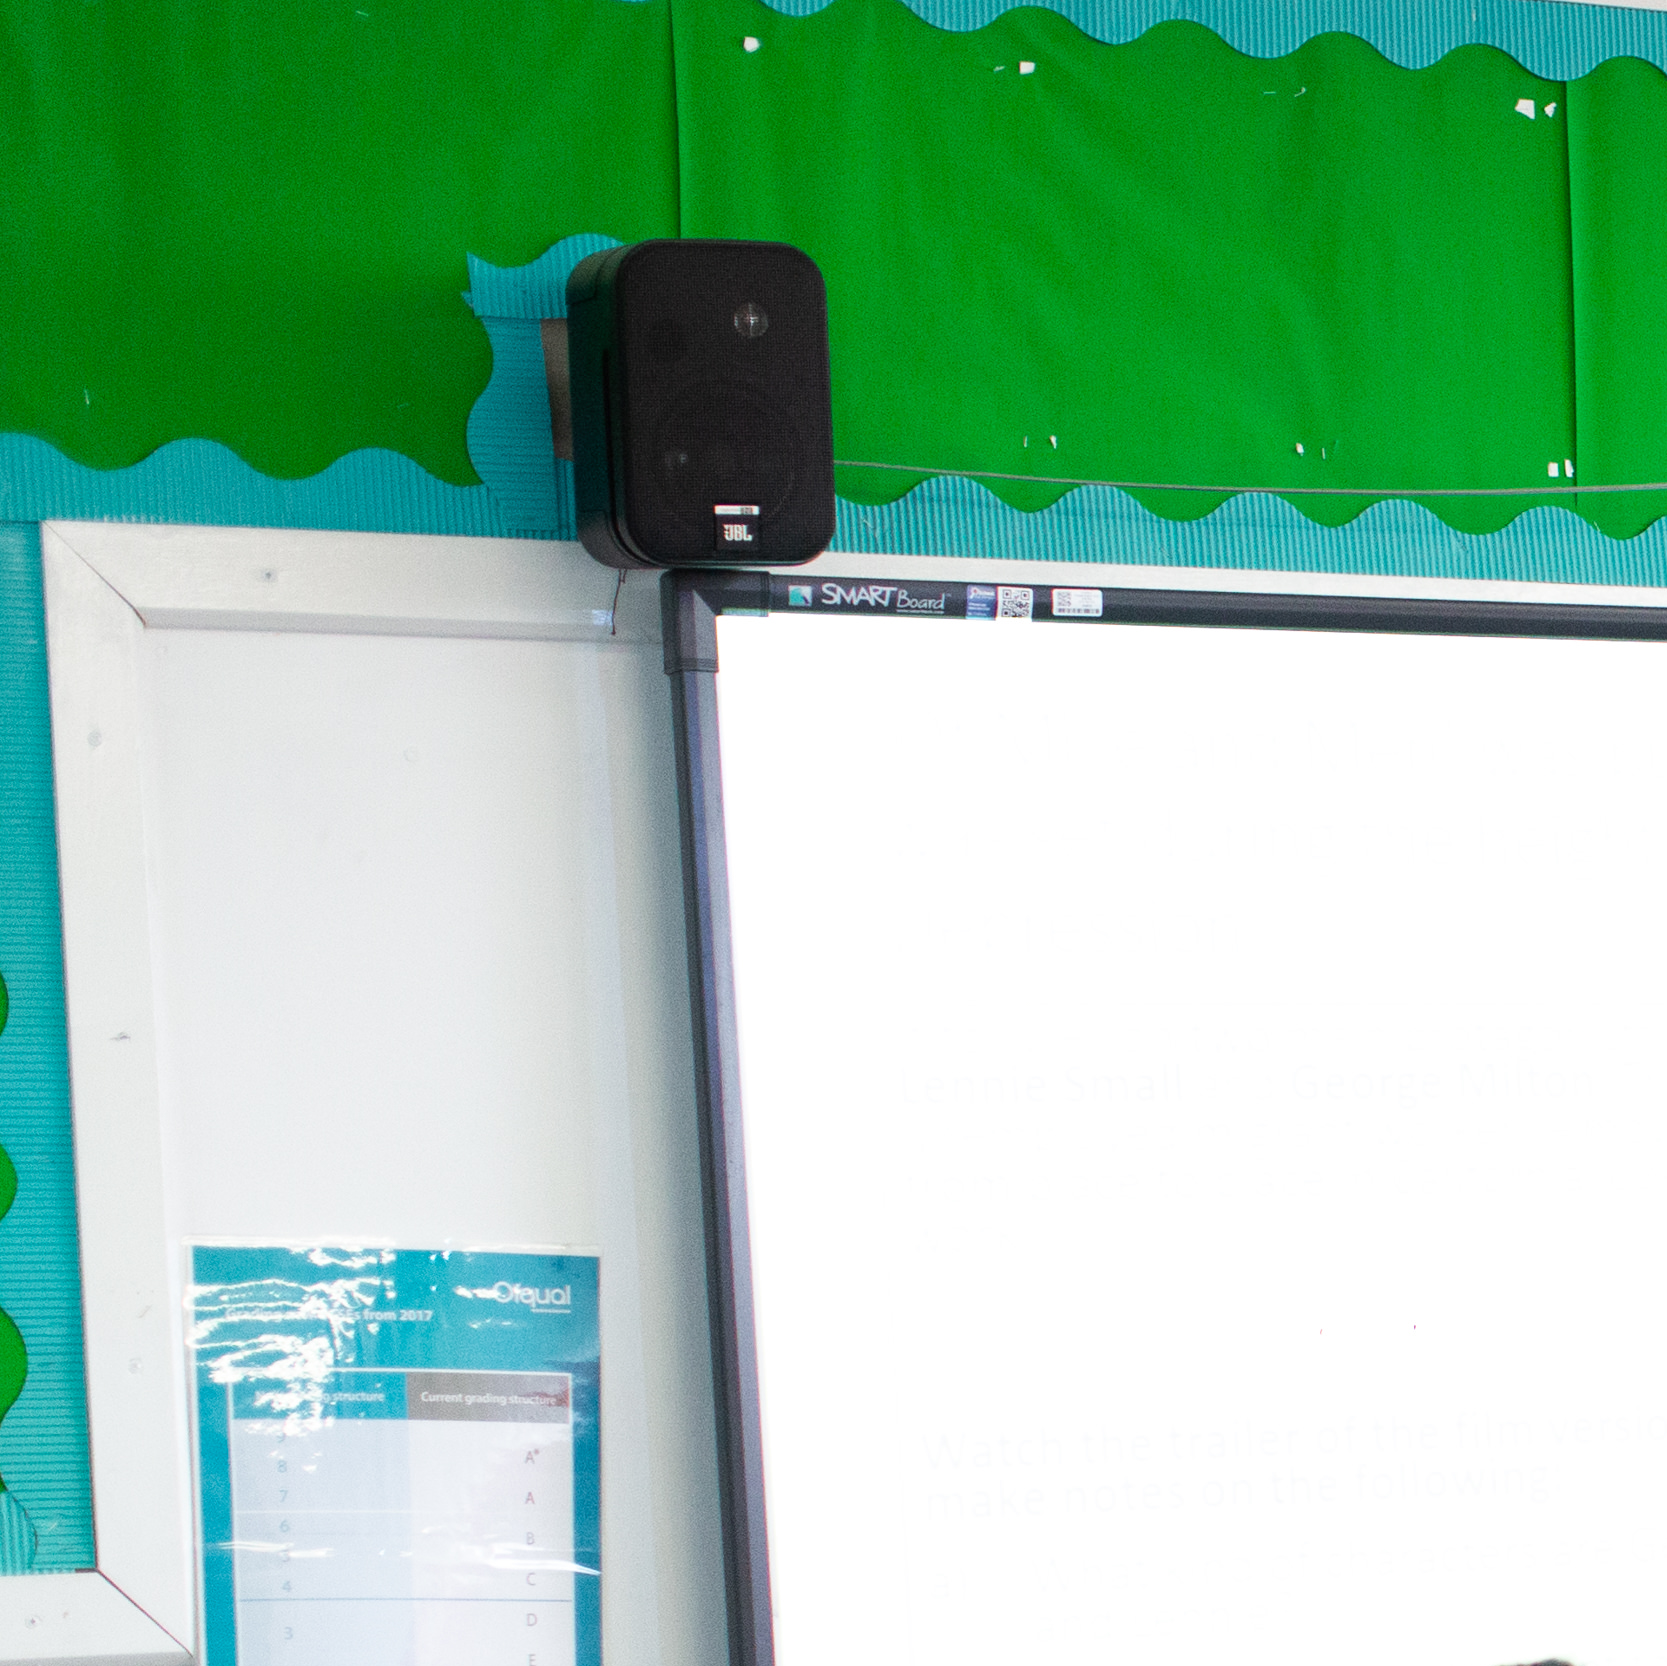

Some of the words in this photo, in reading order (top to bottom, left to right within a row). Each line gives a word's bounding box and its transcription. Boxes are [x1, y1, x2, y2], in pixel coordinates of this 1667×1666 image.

[723, 524, 753, 541] JBL
[821, 582, 897, 607] SMART
[897, 588, 946, 609] Board
[493, 1280, 572, 1307] Ofqual
[364, 1309, 396, 1321] from
[399, 1309, 433, 1322] 2017
[331, 1391, 385, 1403] structure
[421, 1391, 463, 1403] Current
[465, 1393, 506, 1406] grading
[507, 1394, 557, 1406] structure
[525, 1491, 535, 1505] A
[526, 1532, 535, 1545] B
[526, 1572, 537, 1587] C
[526, 1613, 538, 1627] D
[528, 1654, 537, 1666] E
